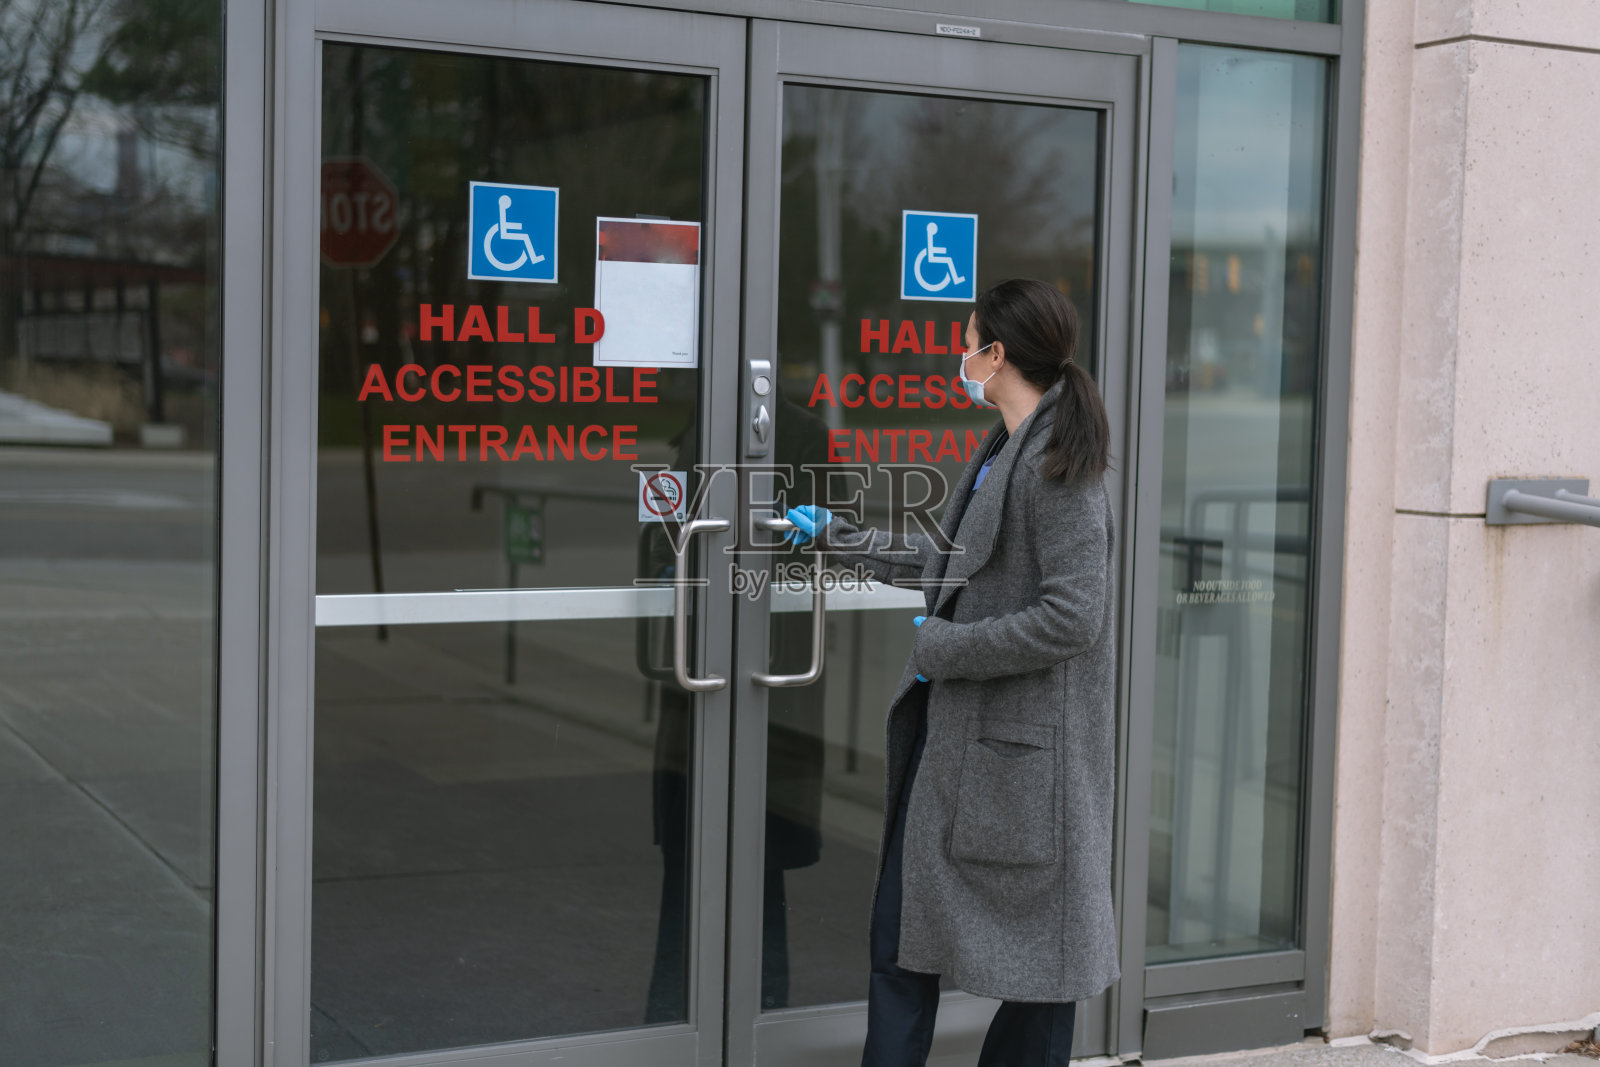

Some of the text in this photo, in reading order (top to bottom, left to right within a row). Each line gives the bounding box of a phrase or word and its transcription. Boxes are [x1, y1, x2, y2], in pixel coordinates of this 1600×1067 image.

[420, 304, 605, 344] HALL D
[860, 319, 966, 354] HALL
[358, 364, 659, 403] ACCESSIBLE
[808, 374, 1000, 410] ACCESS
[383, 425, 639, 462] ENTRANCE
[1193, 580, 1205, 592] NO
